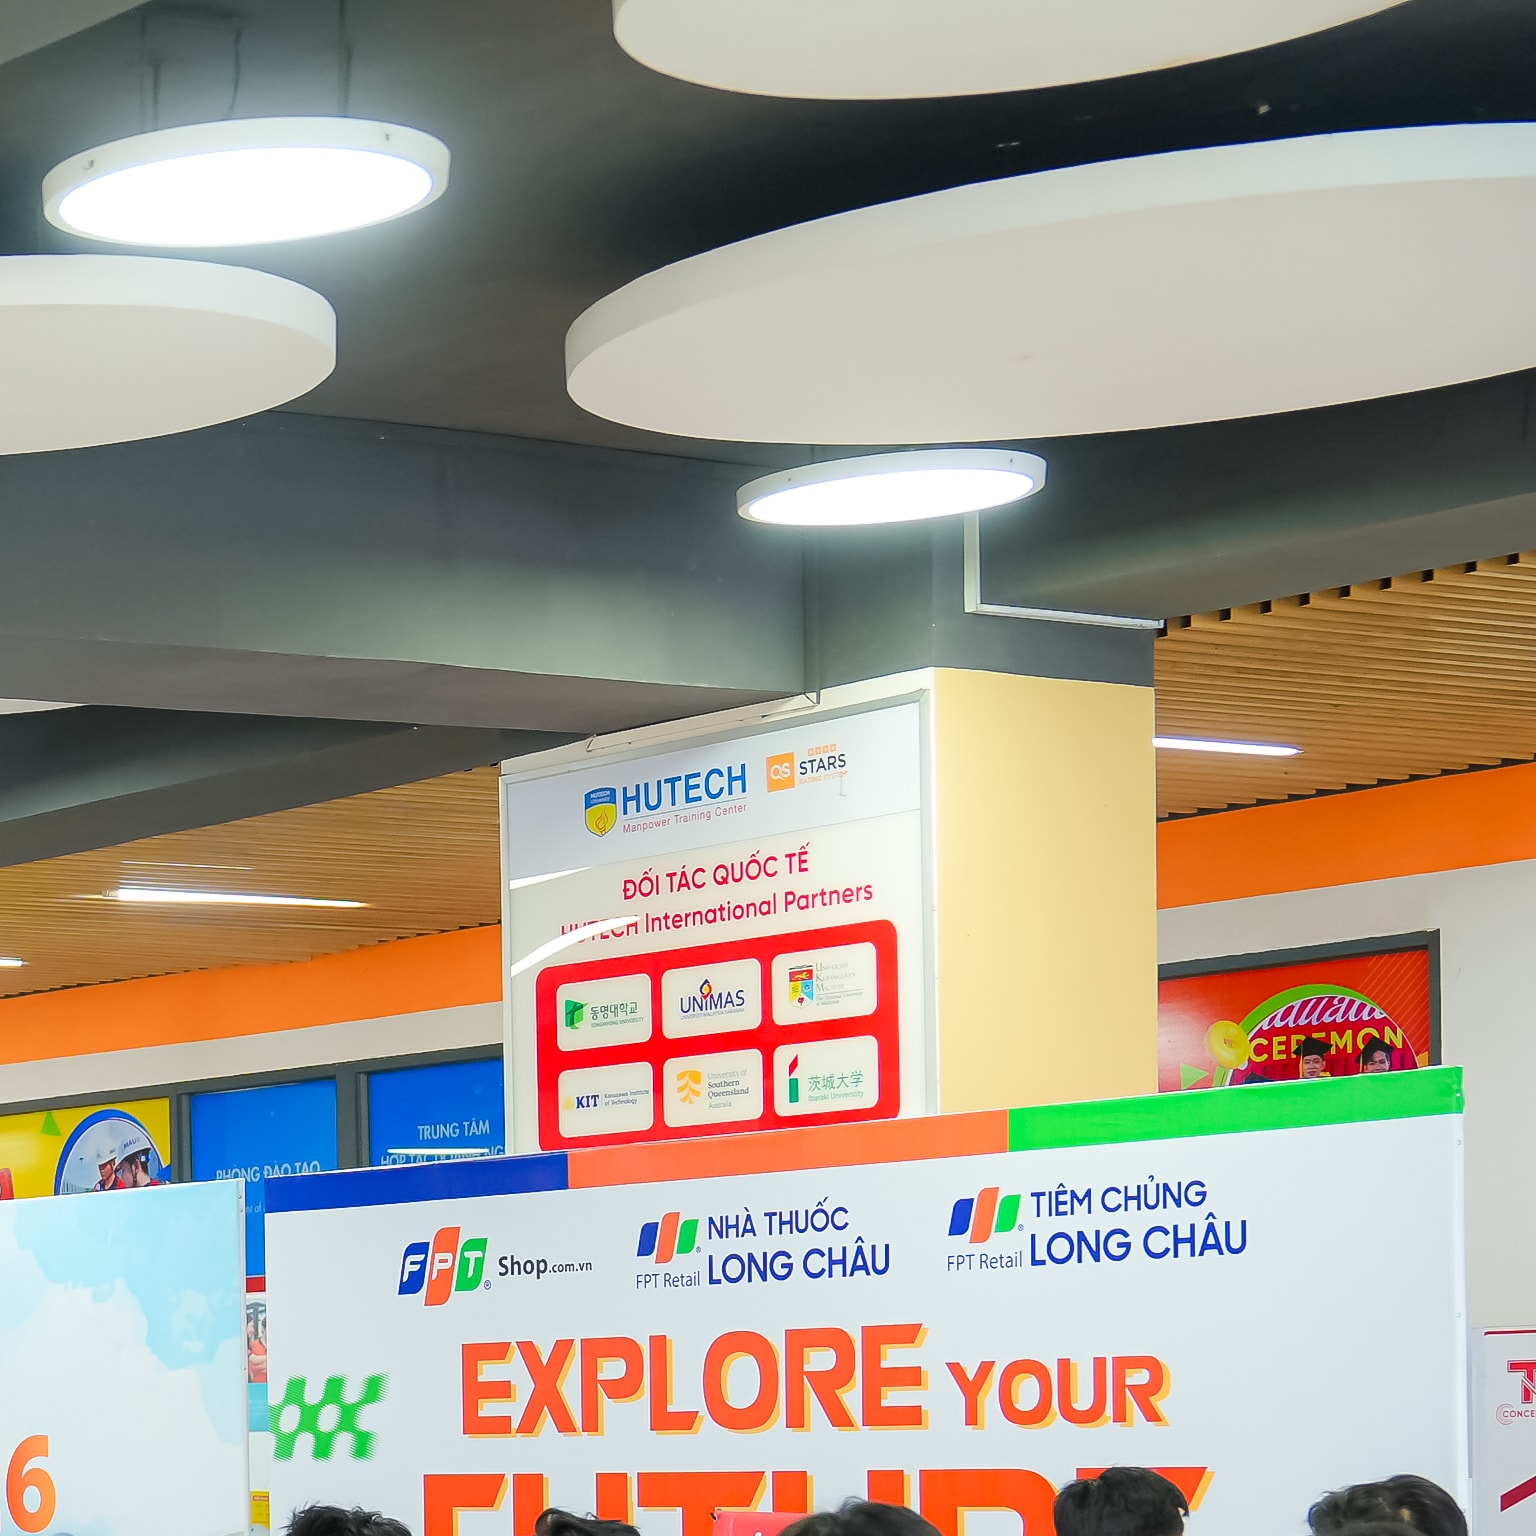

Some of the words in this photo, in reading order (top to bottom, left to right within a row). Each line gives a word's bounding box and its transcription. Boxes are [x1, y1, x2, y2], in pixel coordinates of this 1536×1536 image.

[622, 763, 747, 816] HUTECH
[770, 763, 791, 781] QS
[799, 754, 847, 776] STARS
[622, 817, 671, 834] Manpower
[674, 809, 712, 823] Training
[714, 802, 748, 816] Center
[622, 867, 660, 900] ĐỐI
[666, 865, 706, 892] TÁC
[713, 850, 778, 886] QUỐC
[785, 842, 811, 874] TẾ
[645, 893, 777, 934] International
[784, 883, 874, 913] Partners
[590, 1002, 638, 1021] 동명대학교
[680, 989, 745, 1014] UNIMAS
[708, 1079, 740, 1089] Southern
[708, 1086, 750, 1099] Queensland
[808, 1070, 863, 1092] 茨城大学
[576, 1094, 600, 1109] KIT
[418, 1121, 460, 1141] TRUNG
[1030, 1182, 1093, 1218] TIÊM
[1100, 1174, 1208, 1213] CHỦNG
[707, 1207, 757, 1240] NHÀ
[764, 1197, 850, 1236] THUỐC
[947, 1253, 975, 1271] FPT
[979, 1250, 1024, 1271] Retail
[1030, 1228, 1132, 1267] LONG
[1142, 1211, 1248, 1260] CHÂU
[498, 1255, 593, 1279] Shop.com.vn
[637, 1273, 660, 1290] FPT
[663, 1270, 701, 1288] Retail
[708, 1249, 801, 1286] LONG
[814, 1236, 891, 1278] CHÂU
[461, 1323, 928, 1437] EXPLORE
[945, 1354, 1171, 1428] YOUR
